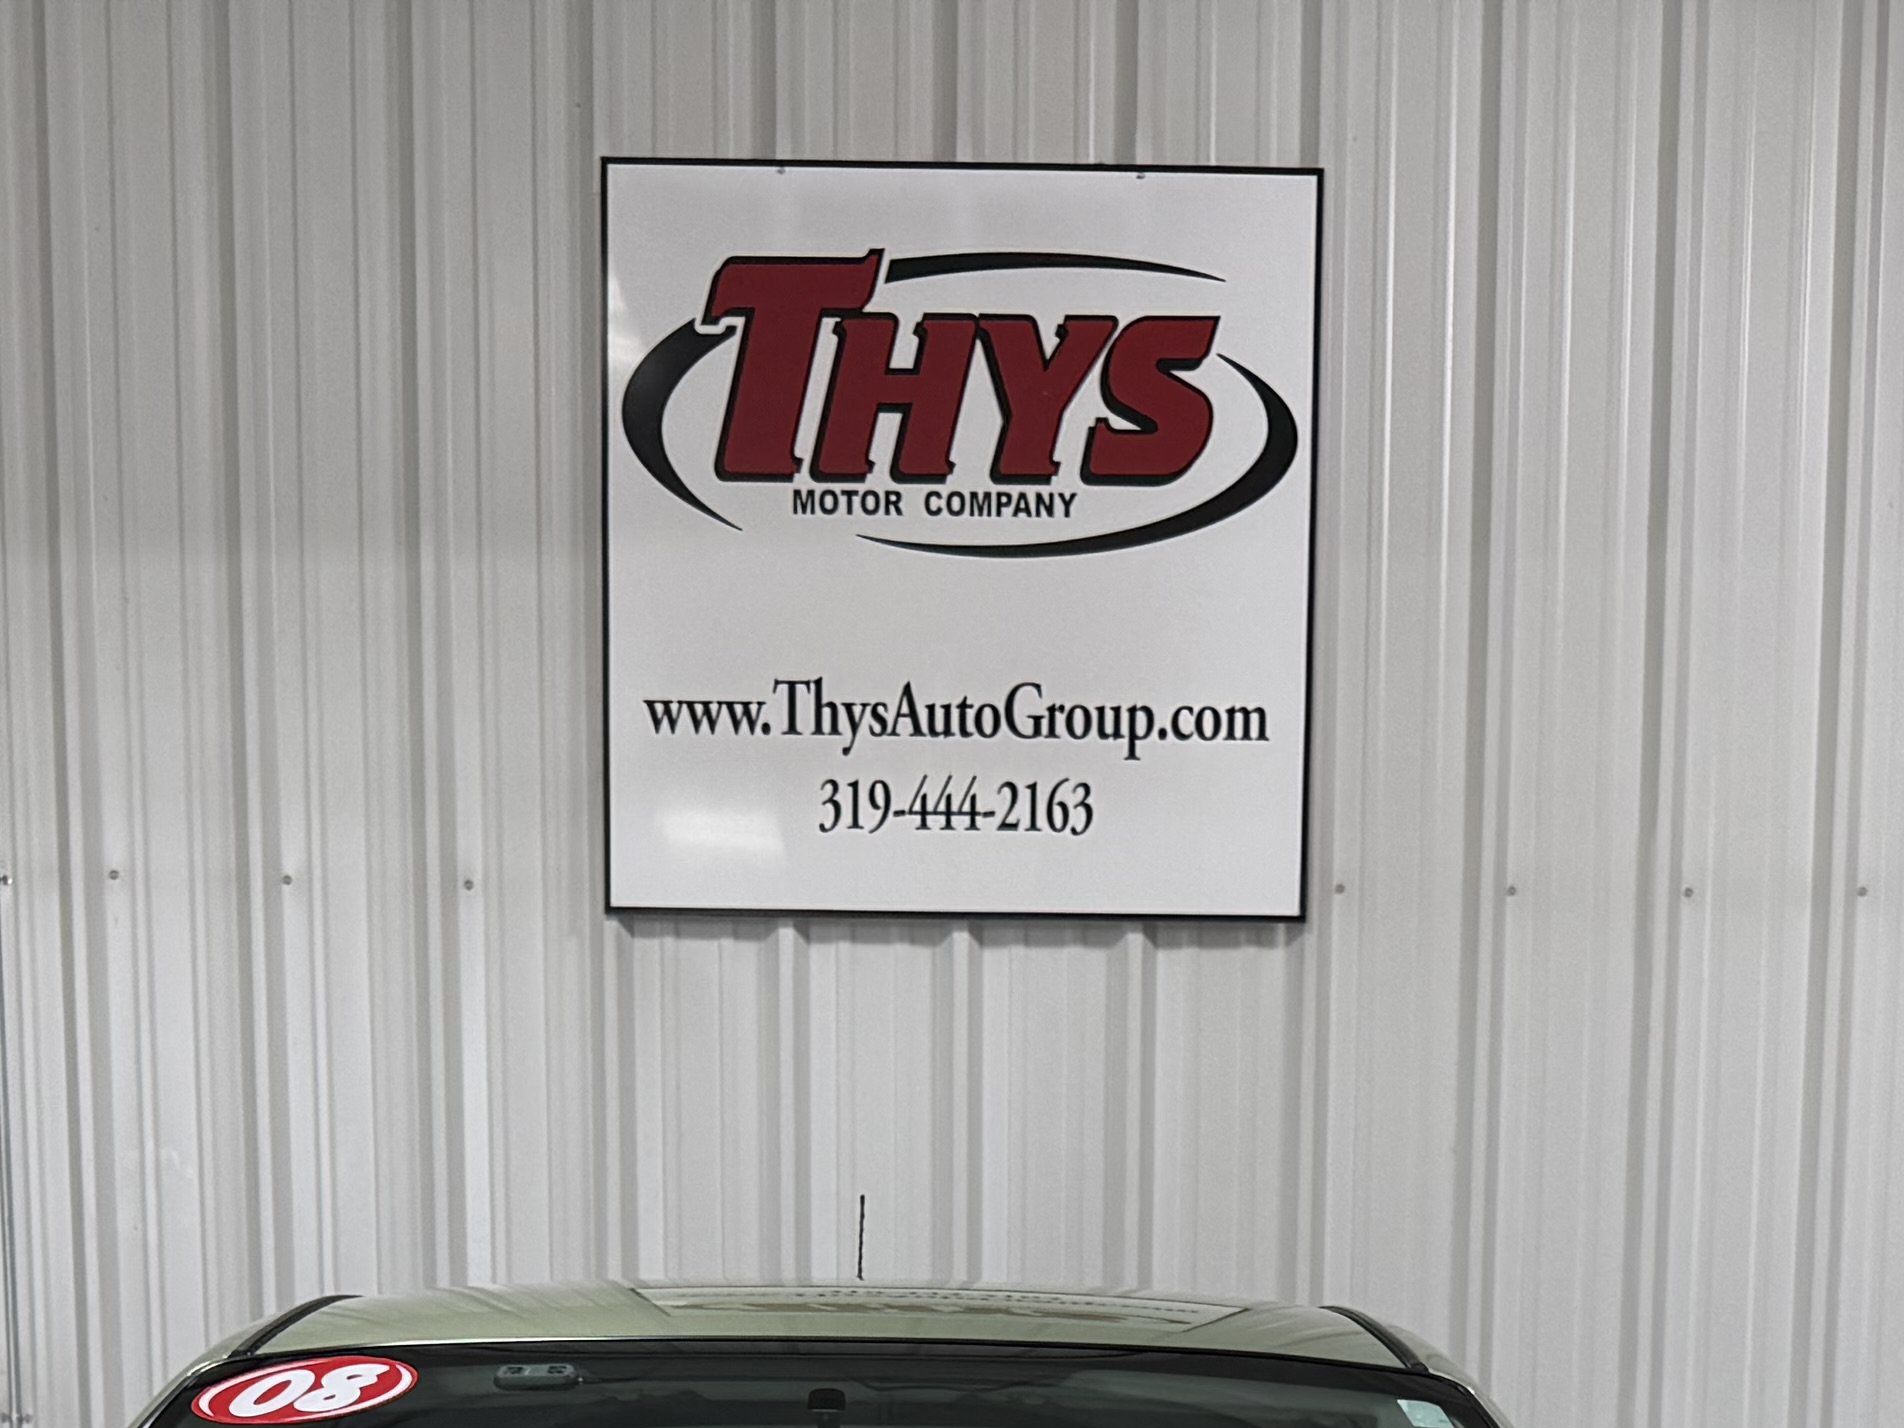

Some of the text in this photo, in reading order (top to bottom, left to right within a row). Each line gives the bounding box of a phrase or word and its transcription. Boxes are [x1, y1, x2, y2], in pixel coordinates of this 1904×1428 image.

[700, 247, 1221, 486] THYS
[792, 489, 1078, 519] MOTOR COMPANY
[643, 677, 1270, 760] www.ThysAutoGroup.com
[819, 774, 1095, 834] 319-444-2163
[229, 1363, 390, 1418] 08
